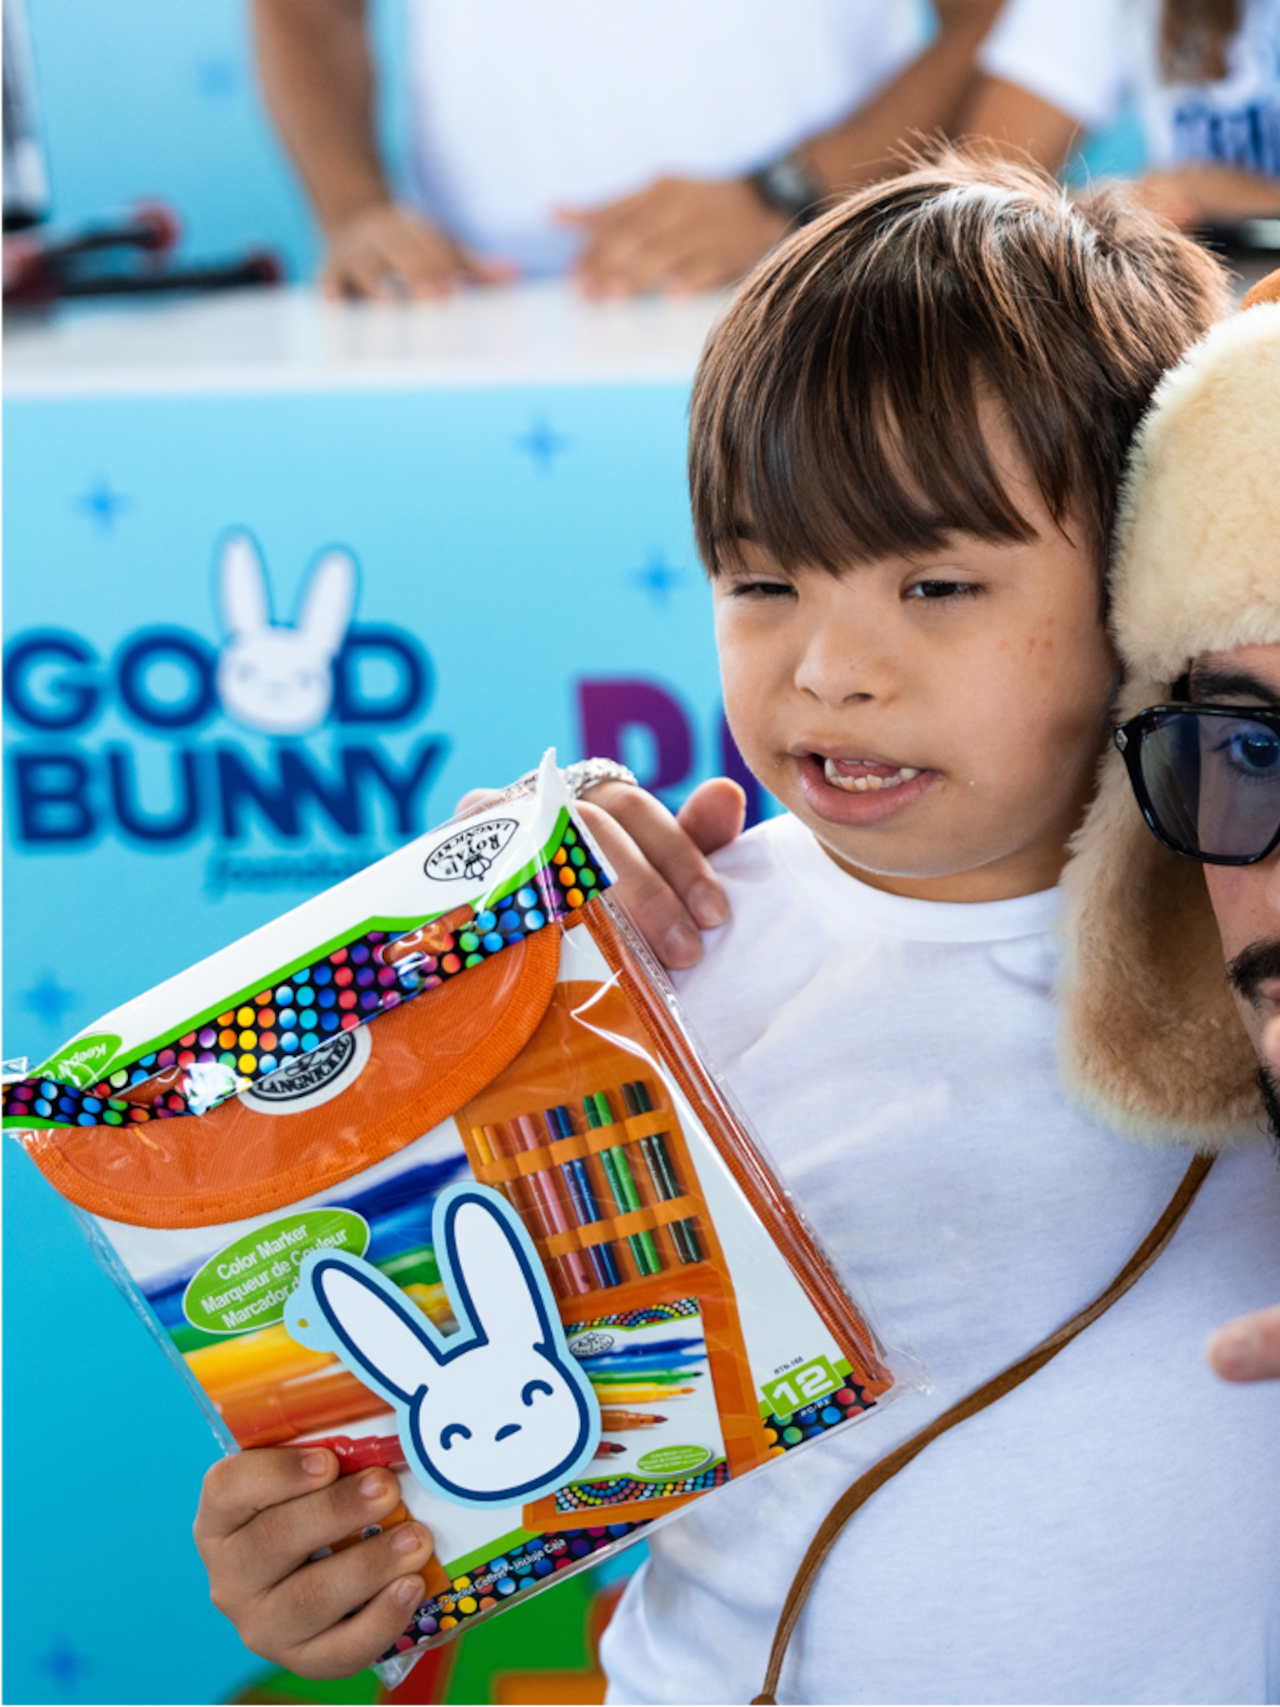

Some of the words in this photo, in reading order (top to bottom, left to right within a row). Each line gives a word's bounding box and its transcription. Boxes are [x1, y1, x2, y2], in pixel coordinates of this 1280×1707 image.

[2, 631, 425, 732] GOD
[13, 742, 443, 842] BUNNY
[70, 1042, 107, 1064] Keep
[256, 1036, 351, 1093] LANGNICKEL
[216, 1249, 259, 1281] Color
[255, 1223, 308, 1259] Marker
[201, 1269, 271, 1315] Marqueur
[270, 1257, 292, 1279] de
[221, 1284, 290, 1329] Marcador
[771, 1364, 835, 1406] 12
